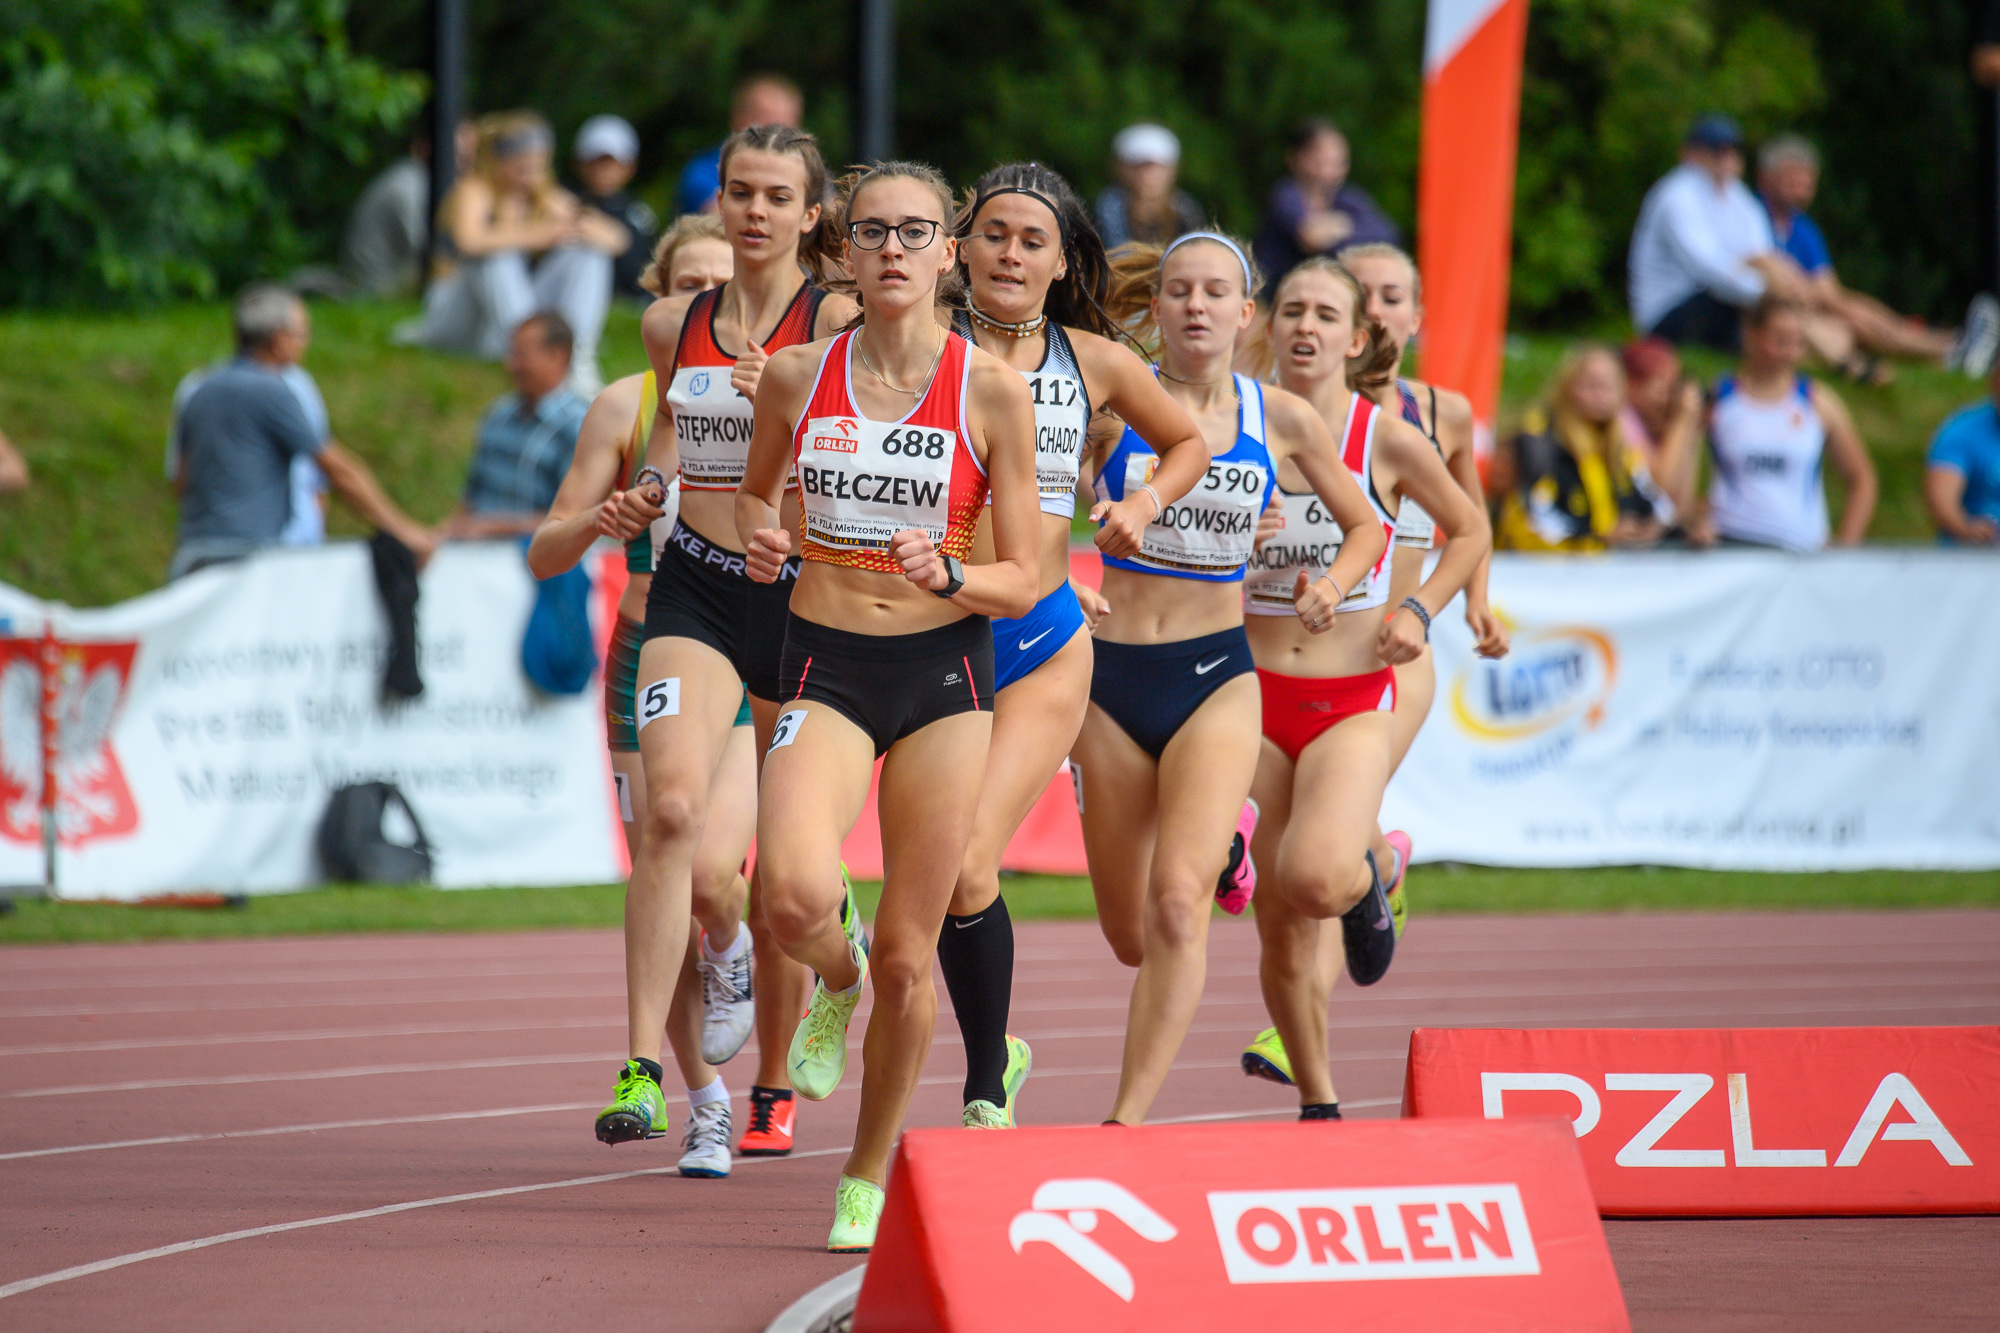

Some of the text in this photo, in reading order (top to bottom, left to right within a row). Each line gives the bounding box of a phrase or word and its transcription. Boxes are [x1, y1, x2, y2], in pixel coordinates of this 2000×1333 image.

[1029, 377, 1077, 407] 117
[676, 414, 754, 448] STĘPKOW
[815, 438, 855, 452] ORLEN
[882, 428, 945, 460] 688
[803, 466, 944, 508] BEŁCZEW
[1060, 475, 1077, 484] U18
[1204, 466, 1259, 494] 590
[807, 515, 818, 526] 54.
[819, 519, 833, 532] PZLA
[834, 523, 892, 536] Mistrzostwa
[809, 528, 861, 546] BIELSKO-BIAŁA
[644, 682, 668, 719] 5
[768, 714, 794, 752] 6
[1481, 1072, 1974, 1167] PZLA
[1236, 1202, 1514, 1269] ORLEN
